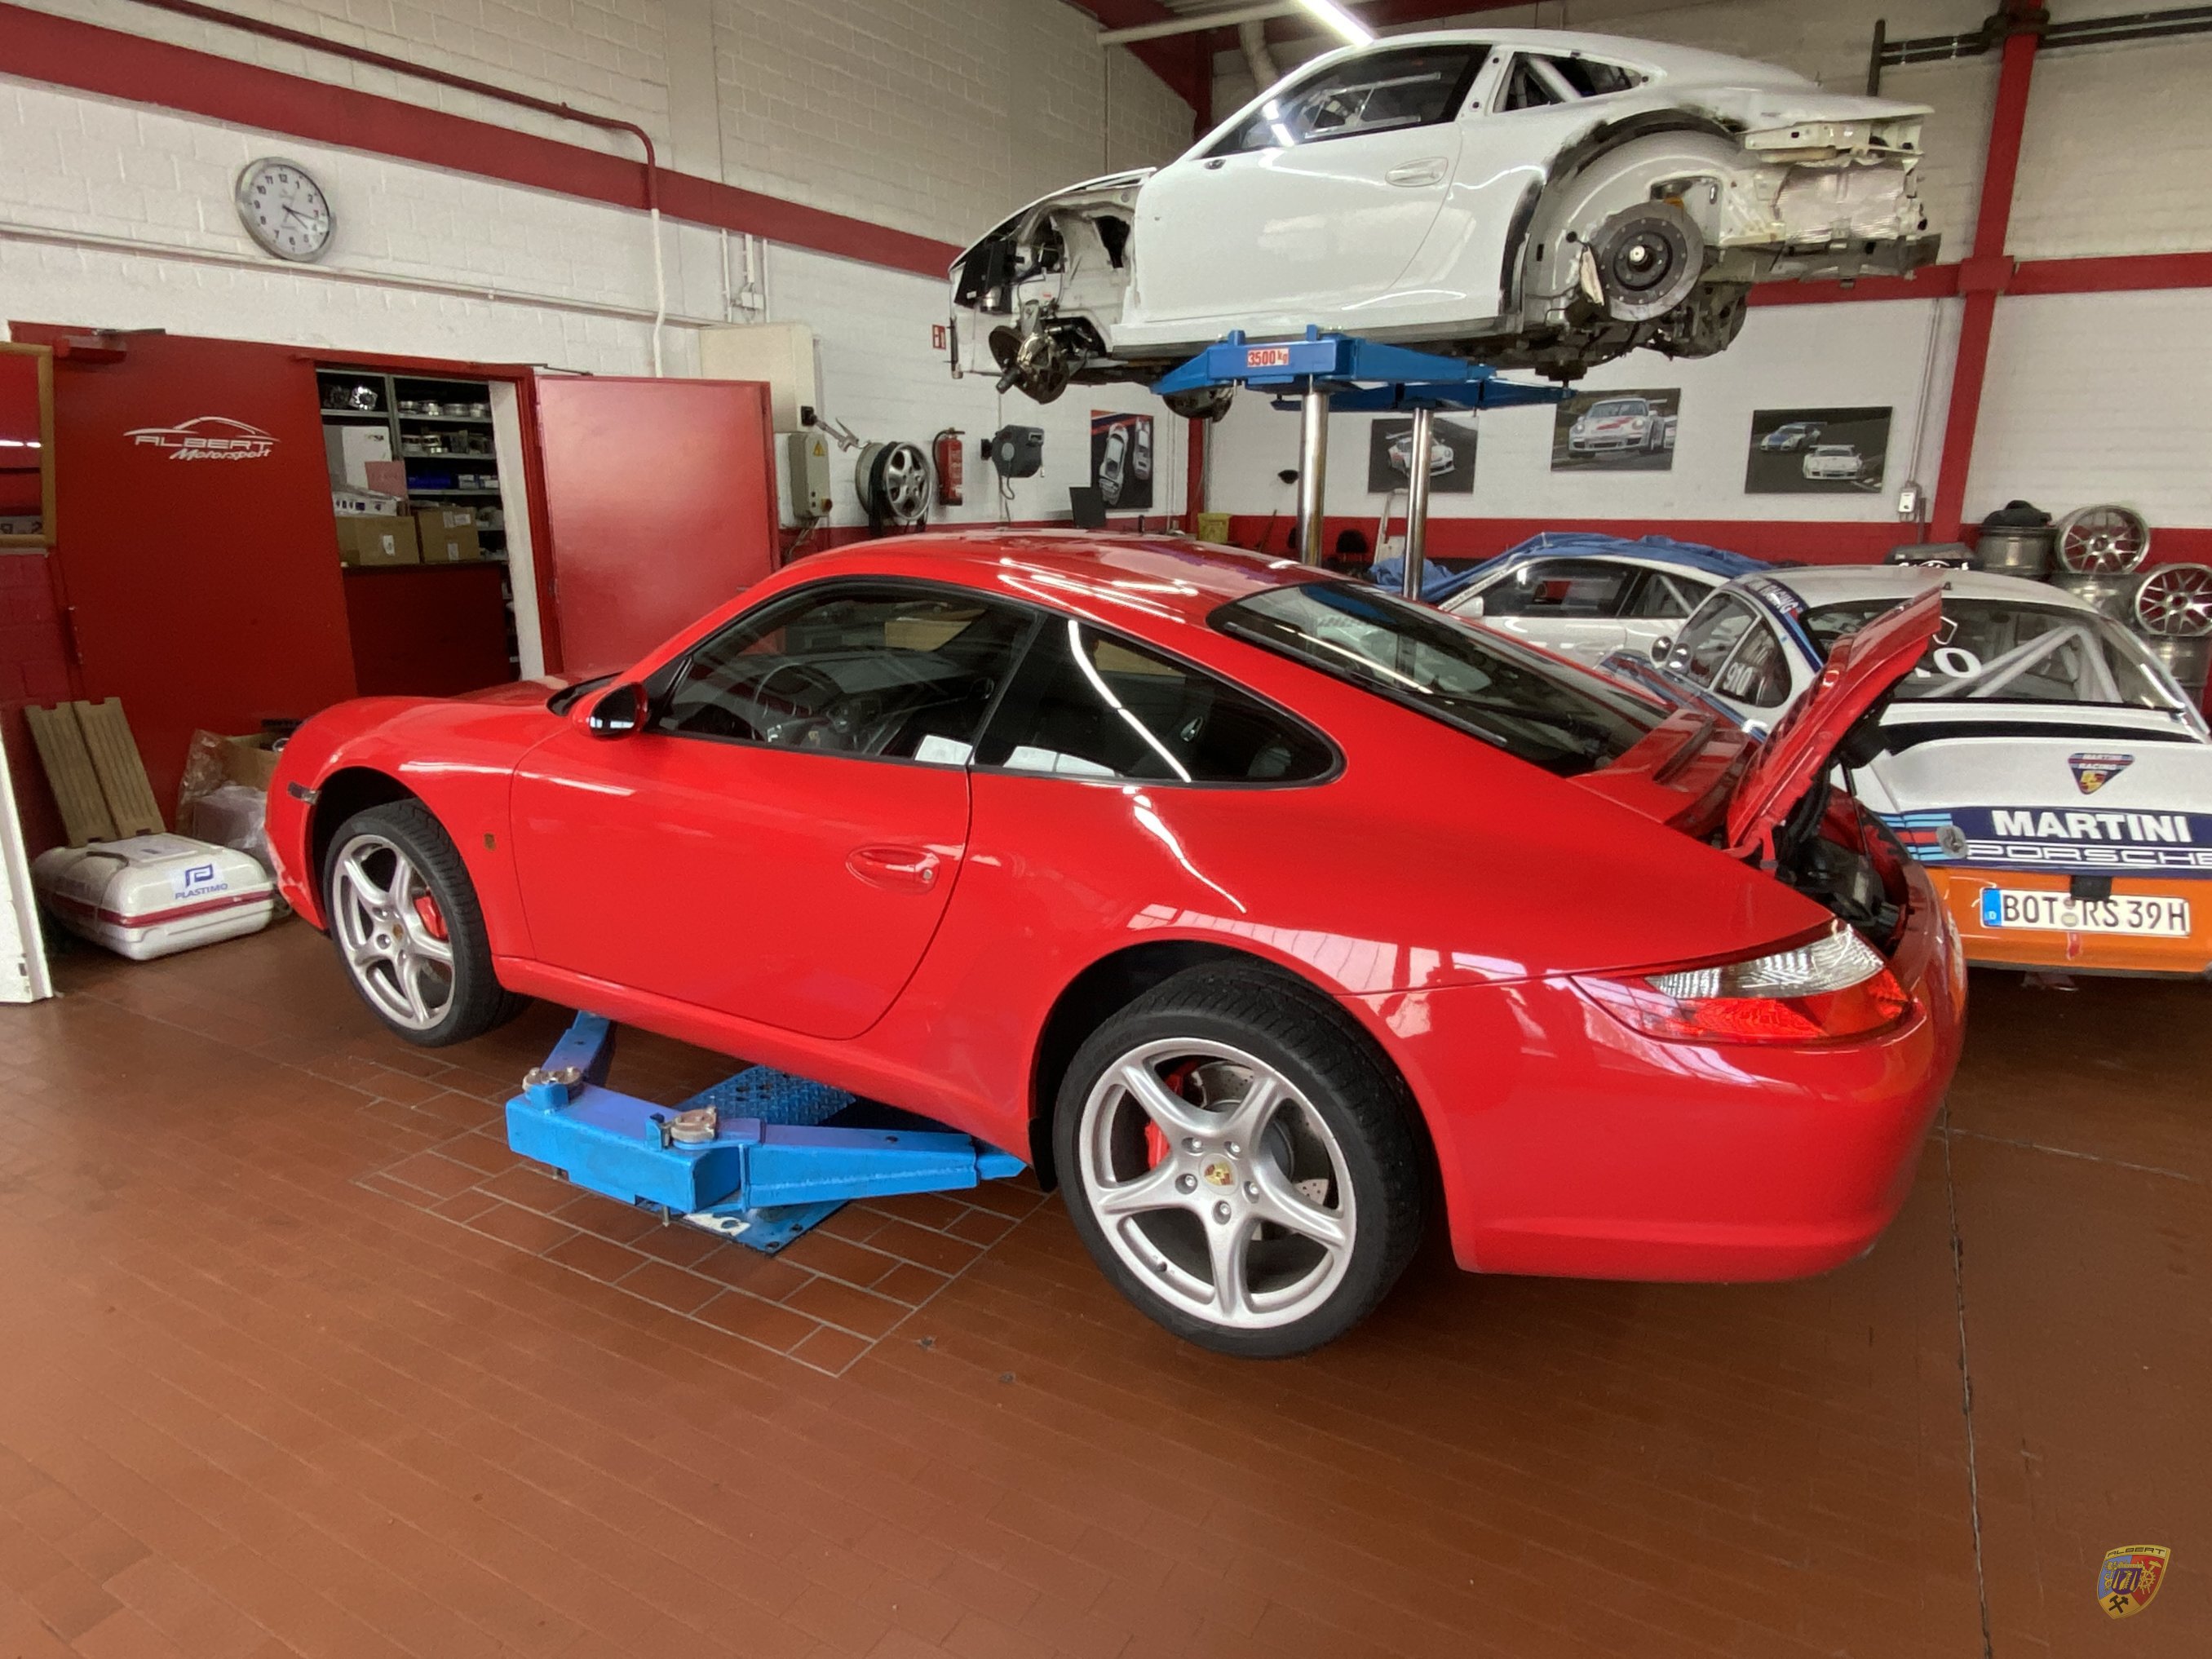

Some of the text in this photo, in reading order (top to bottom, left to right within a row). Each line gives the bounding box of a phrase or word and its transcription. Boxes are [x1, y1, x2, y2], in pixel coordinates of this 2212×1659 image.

[1249, 350, 1288, 365] 3500 kg
[135, 436, 274, 450] ALBERT
[169, 448, 272, 461] Motorsport
[1991, 810, 2192, 843] MARTINI
[175, 883, 228, 899] PLASTIMO
[2002, 894, 2059, 924] BOT
[2083, 899, 2120, 928] RS
